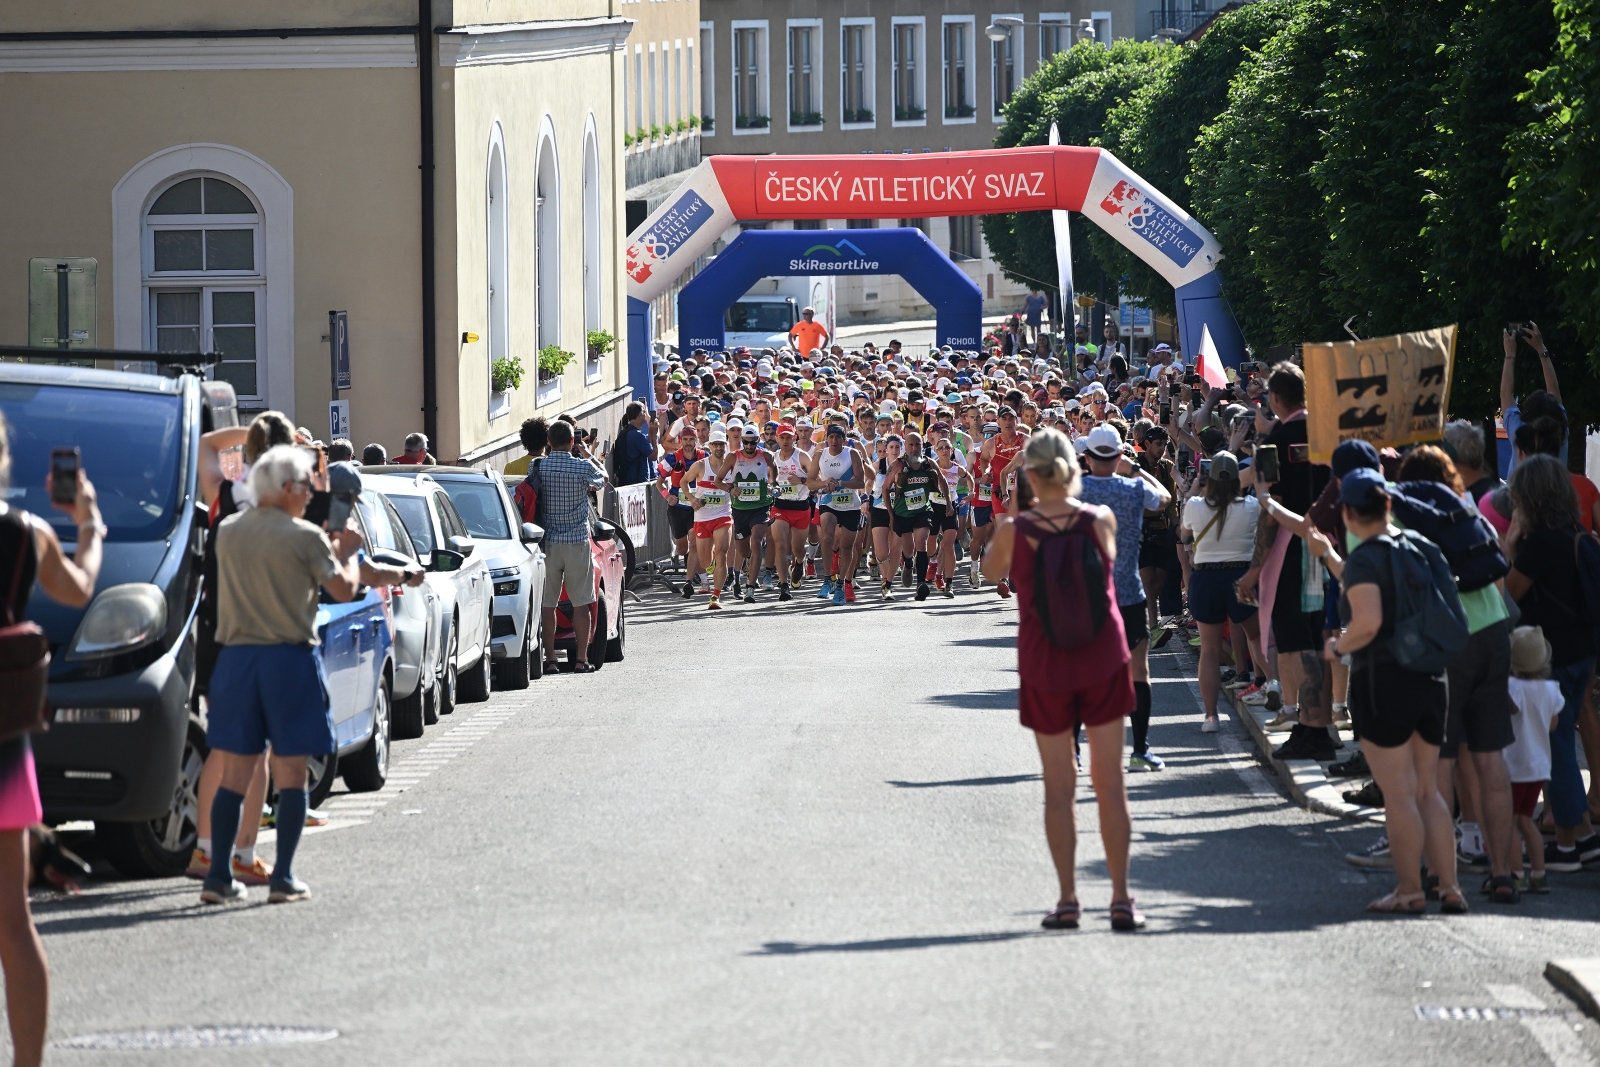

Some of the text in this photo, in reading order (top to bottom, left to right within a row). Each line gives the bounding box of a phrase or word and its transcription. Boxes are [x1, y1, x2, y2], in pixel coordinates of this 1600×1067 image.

[765, 169, 1046, 202] ČESKÝ ATLETICKÝ SVAZ
[654, 208, 679, 233] ČESKÝ
[661, 197, 703, 241] ATLETICKÝ
[1156, 210, 1184, 234] ČESKÝ
[668, 226, 692, 248] SVAZ
[1142, 227, 1167, 248] SVAZ
[1148, 219, 1196, 257] ATLETICKÝ
[789, 258, 879, 270] SkiResortLive
[690, 338, 720, 346] SCHOOL
[946, 337, 977, 345] SCHOOL
[333, 411, 338, 431] P
[909, 495, 922, 503] 498
